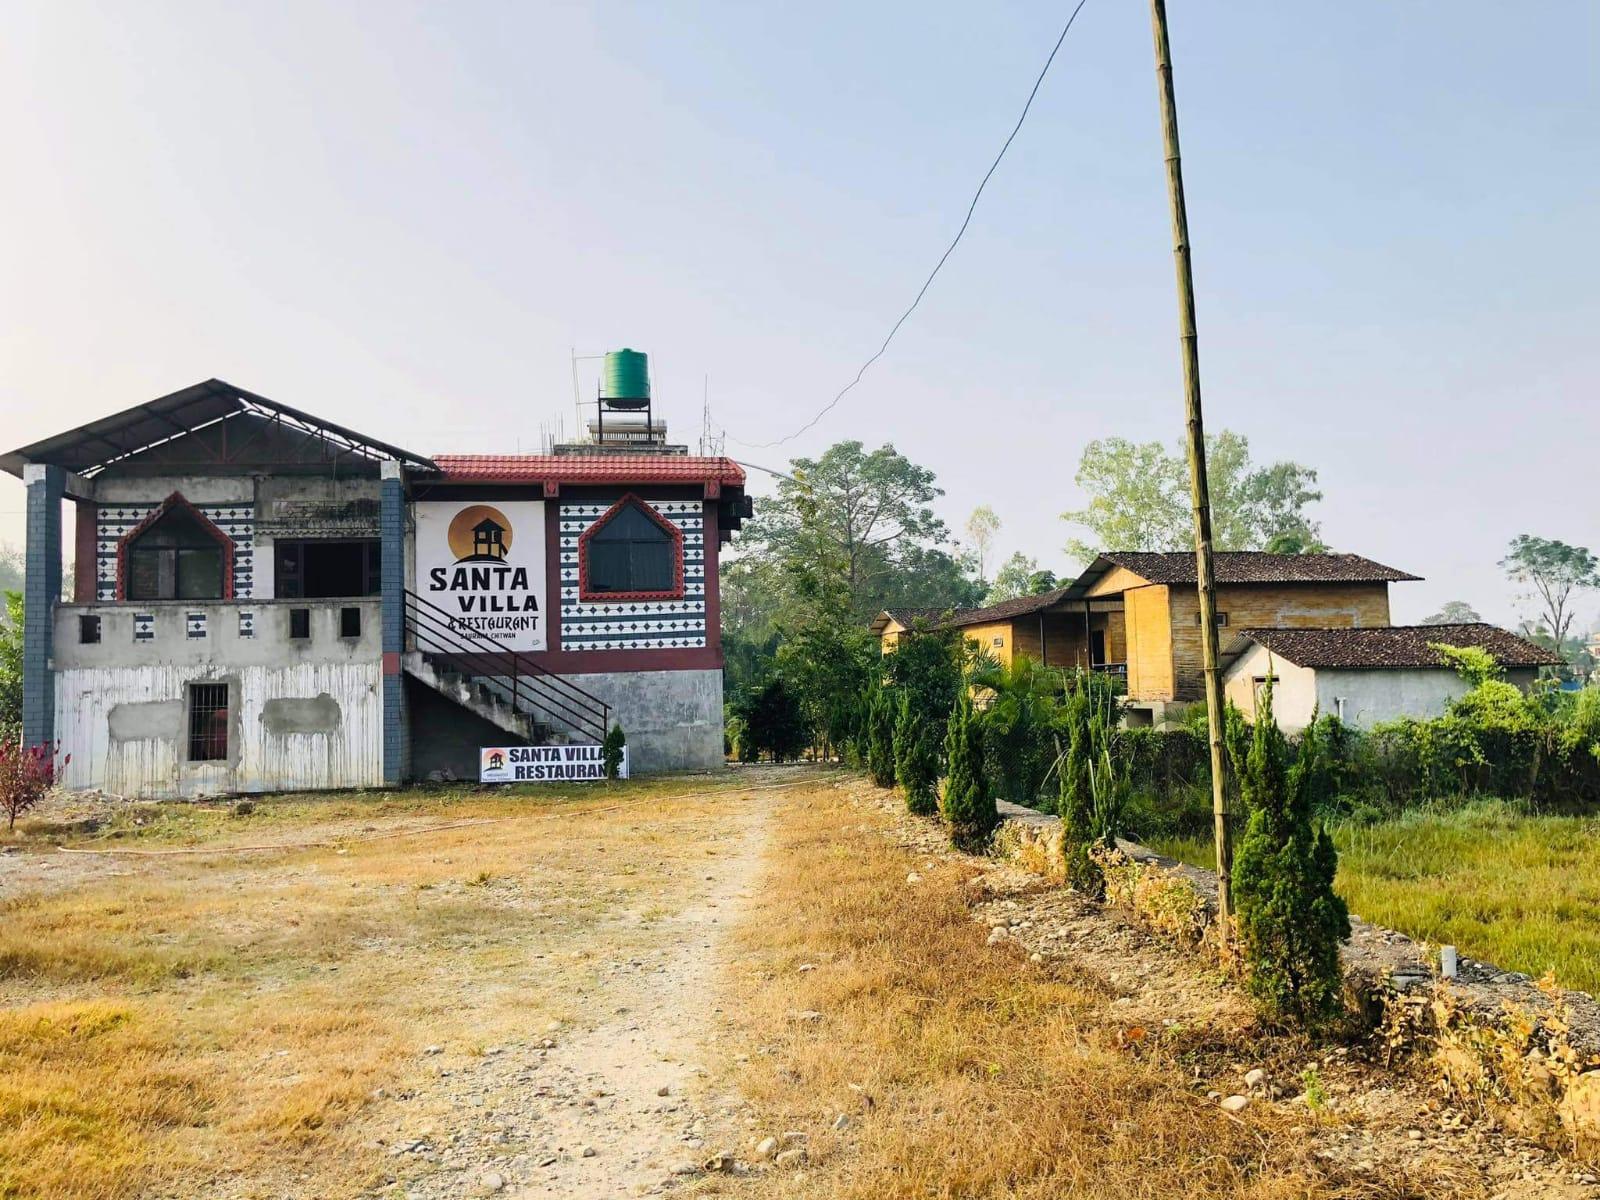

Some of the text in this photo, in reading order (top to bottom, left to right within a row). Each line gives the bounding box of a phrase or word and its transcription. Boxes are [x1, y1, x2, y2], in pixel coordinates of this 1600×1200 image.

[429, 567, 529, 591] SANTA
[457, 595, 539, 612] VILLA
[509, 747, 607, 763] SANTA VILLA
